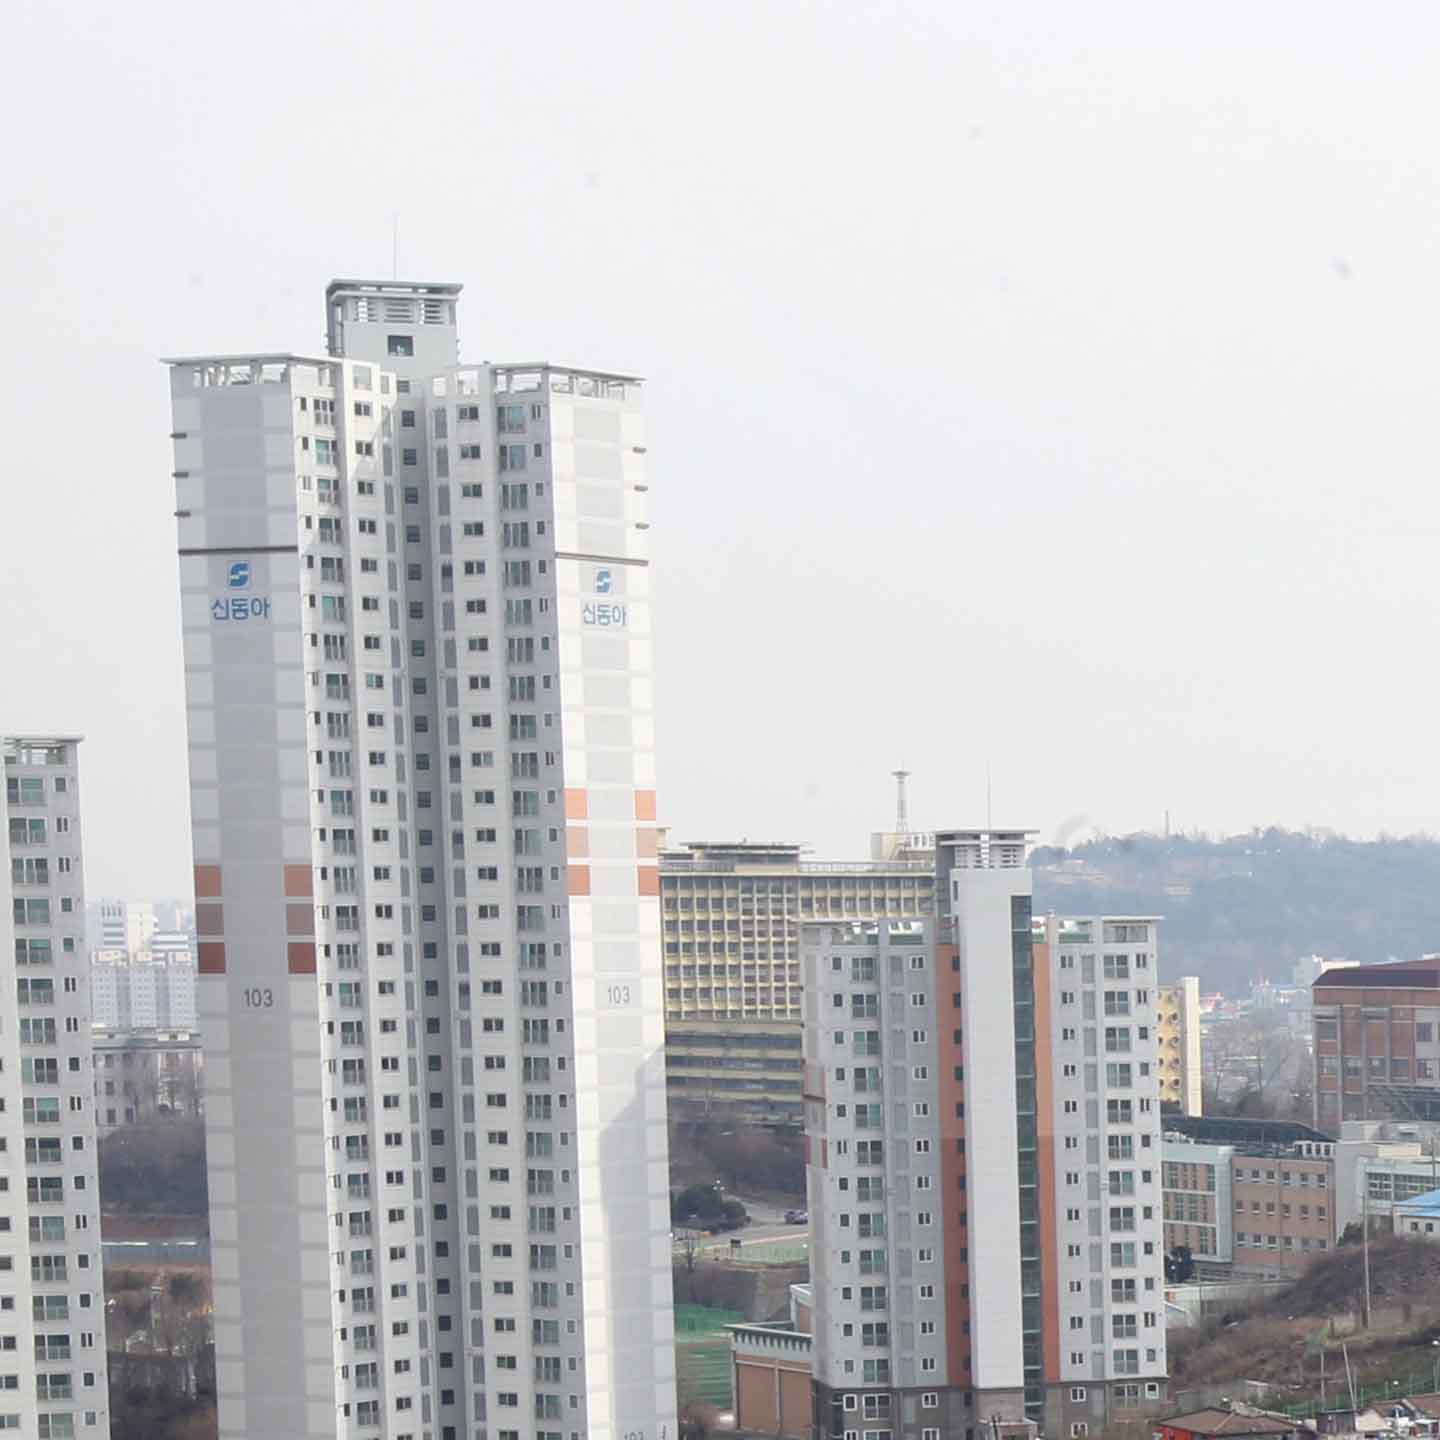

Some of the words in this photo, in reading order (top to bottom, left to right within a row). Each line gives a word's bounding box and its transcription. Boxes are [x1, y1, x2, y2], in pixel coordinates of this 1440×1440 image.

[211, 597, 272, 622] 신동아
[582, 601, 627, 627] 신동아
[244, 989, 273, 1008] 103
[608, 987, 630, 1005] 103
